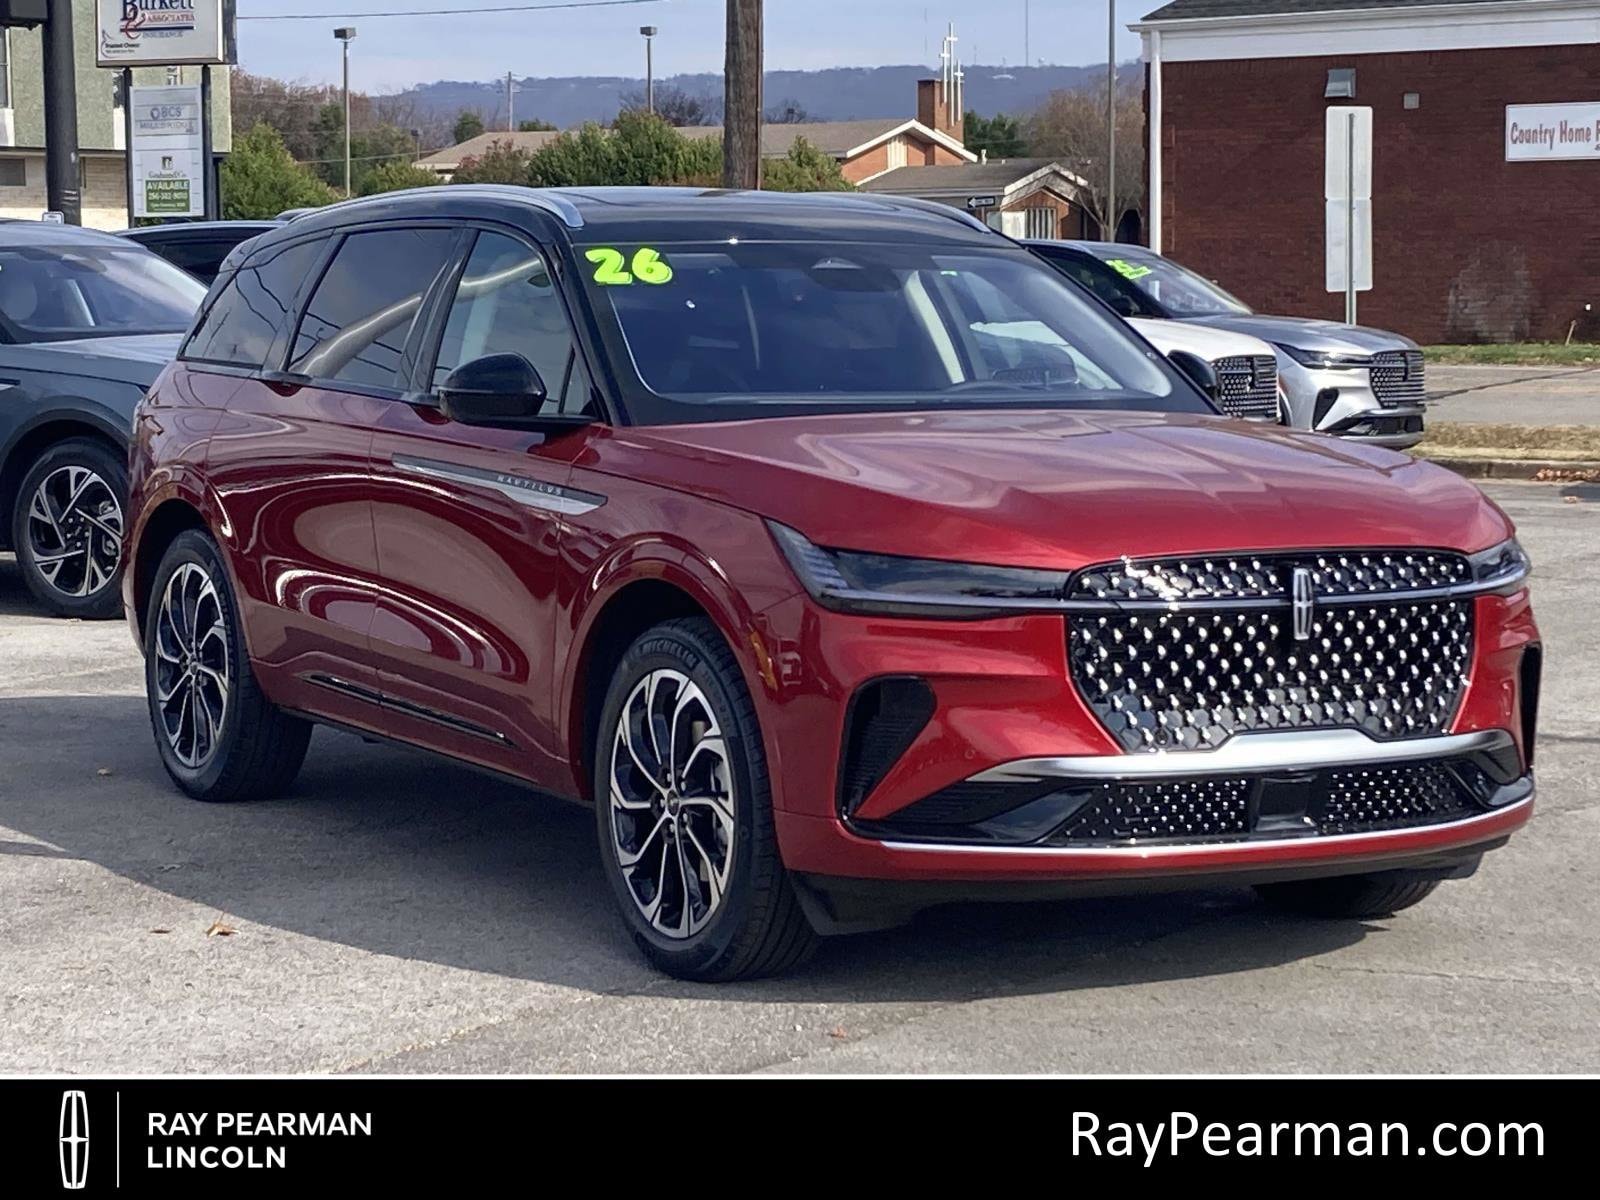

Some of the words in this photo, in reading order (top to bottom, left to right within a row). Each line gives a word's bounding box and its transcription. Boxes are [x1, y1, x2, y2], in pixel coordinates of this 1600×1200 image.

[147, 13, 195, 23] ASSOCIATES
[1510, 121, 1555, 151] Country
[1559, 119, 1591, 143] Home
[146, 180, 190, 190] AVAILABLE
[585, 247, 673, 285] 26
[642, 639, 697, 668] MICHELIN
